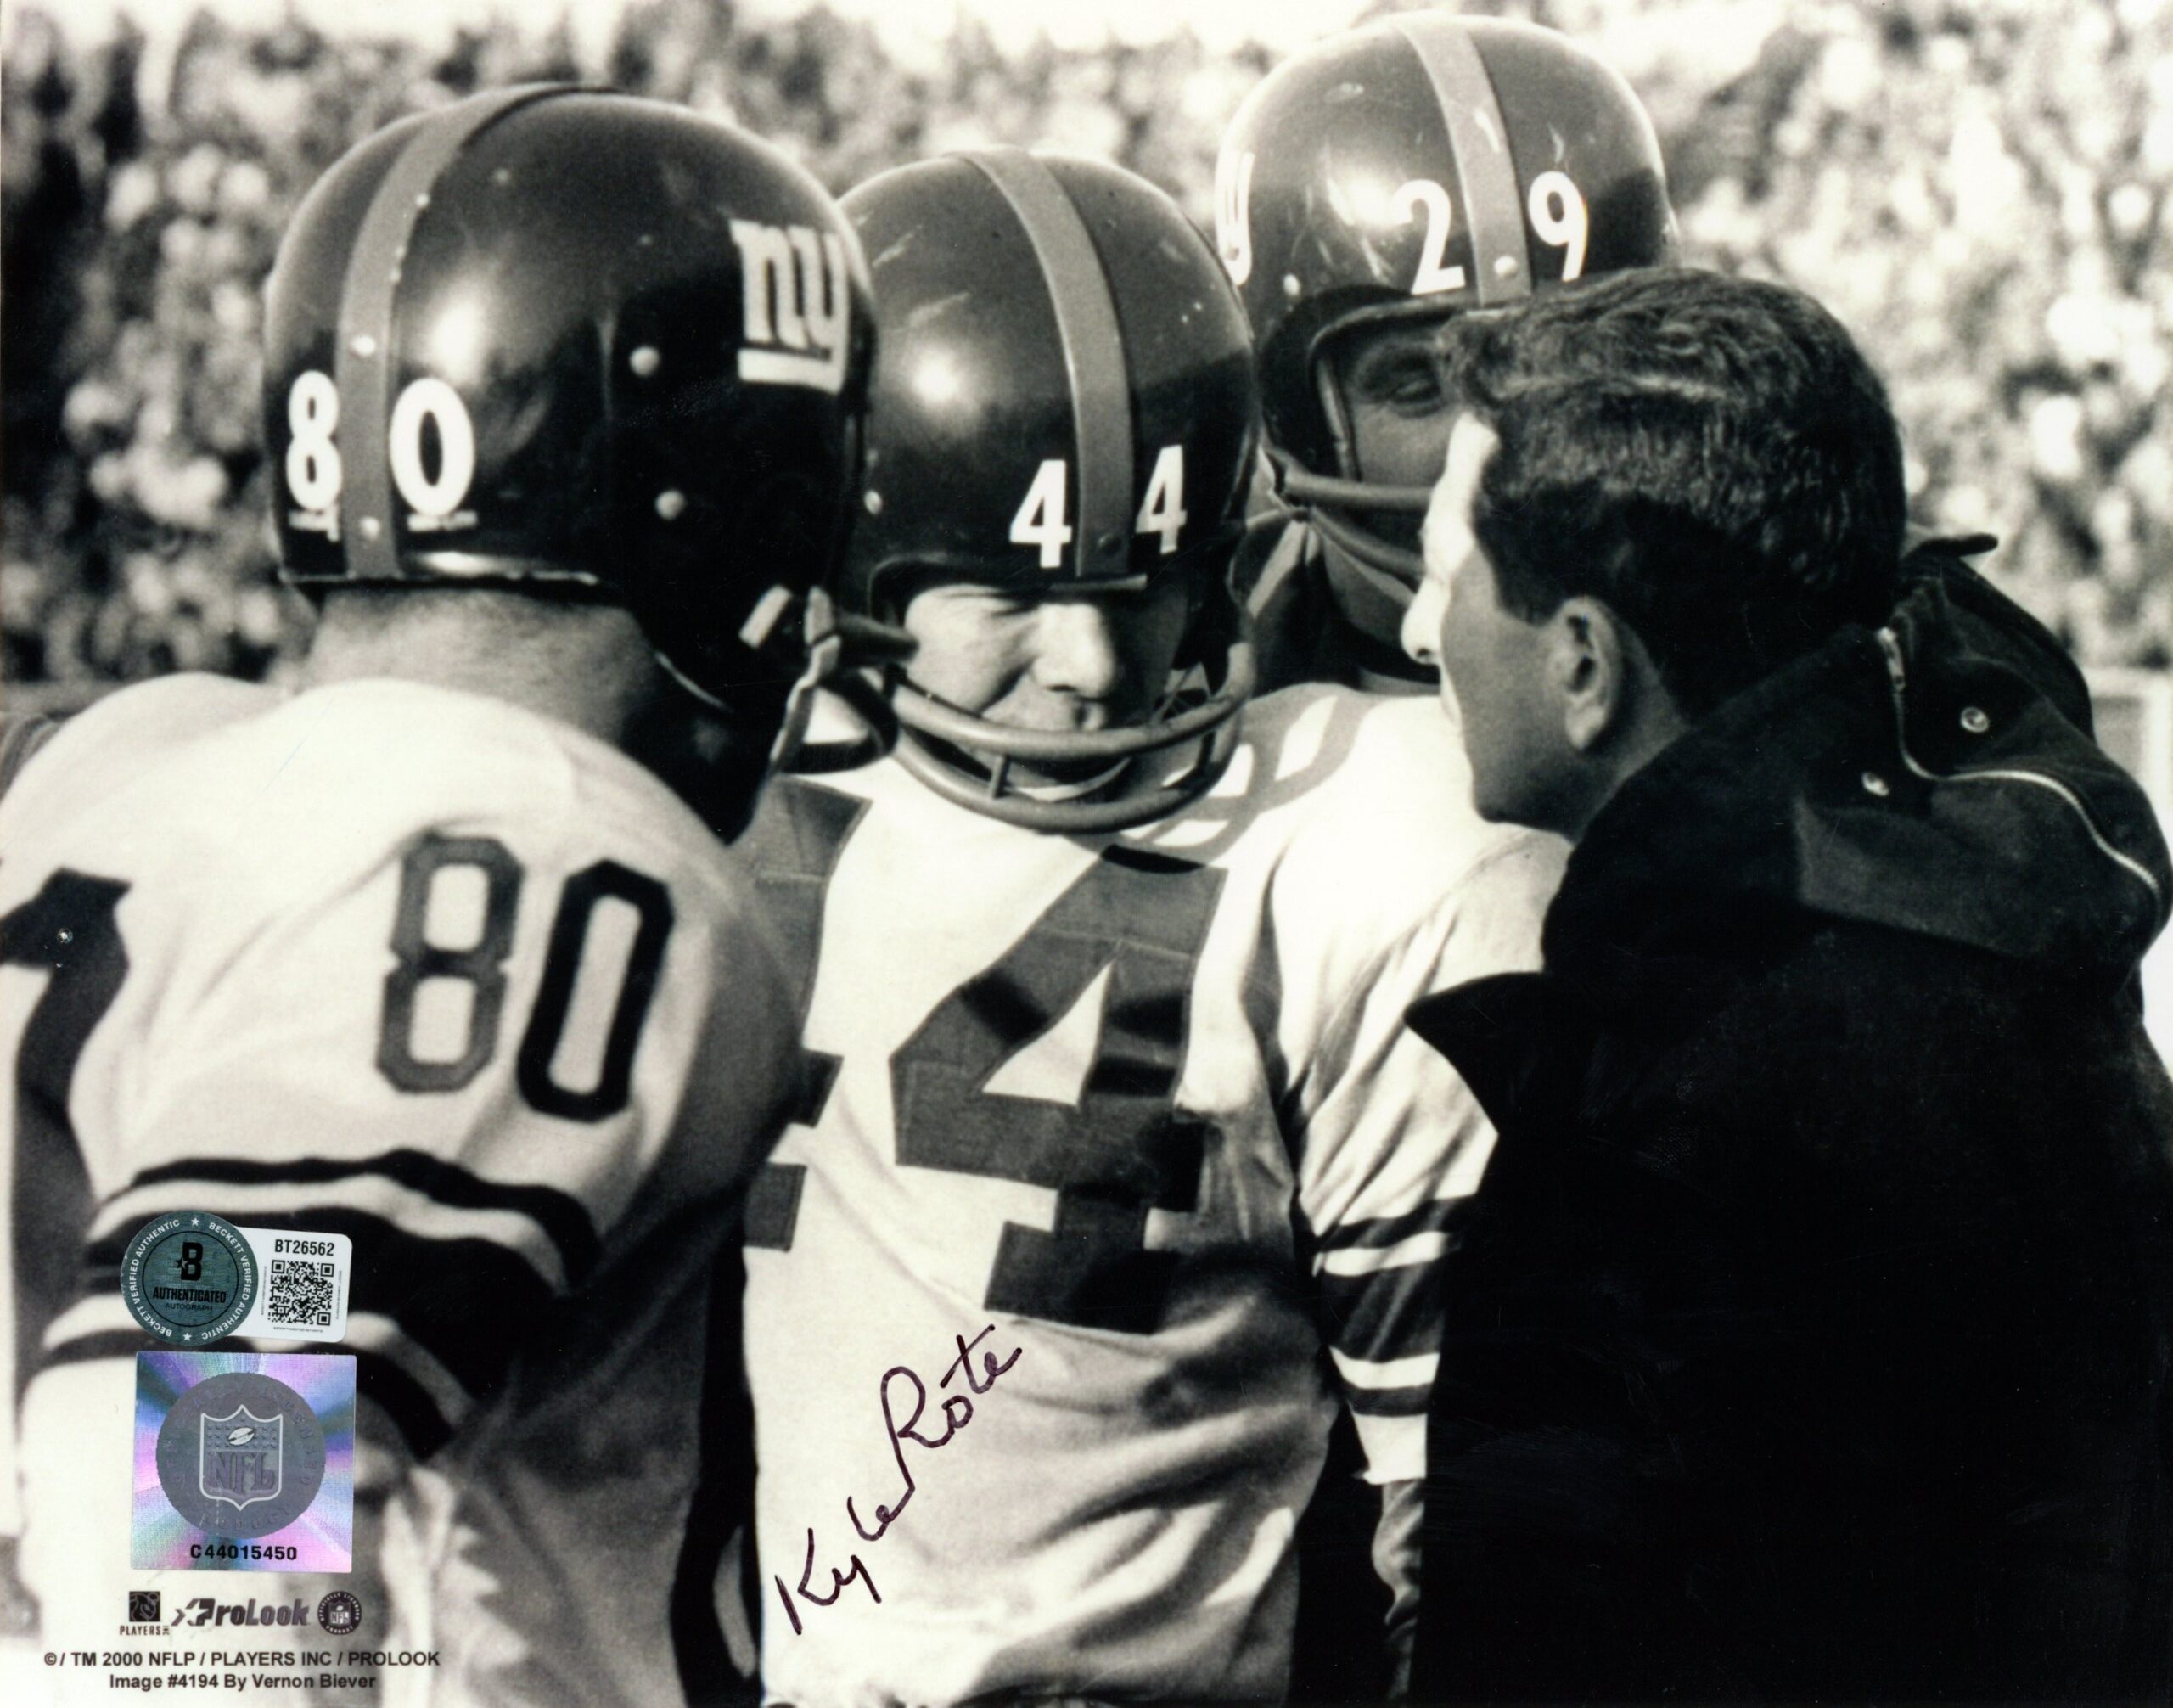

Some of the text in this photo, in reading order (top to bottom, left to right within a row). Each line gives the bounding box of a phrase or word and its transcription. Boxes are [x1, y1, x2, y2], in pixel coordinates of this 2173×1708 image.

[1390, 169, 1590, 295] 29
[286, 370, 476, 517] 80
[1008, 444, 1188, 570] 44
[376, 835, 676, 1125] 80
[209, 1222, 244, 1255] BECKETT
[274, 1239, 335, 1257] BT26562
[128, 1218, 181, 1338] BECKETT VERIFIED AUTHENTIC
[153, 1286, 227, 1304] AUTHENTICATED
[240, 1254, 252, 1301] VERIFIED
[165, 1301, 214, 1312] AUTOGRAPH
[200, 1301, 247, 1341] AUTHENTIC
[207, 1451, 277, 1495] NFL
[773, 1323, 1024, 1637] Kyle Rote
[189, 1543, 298, 1561] C44015450
